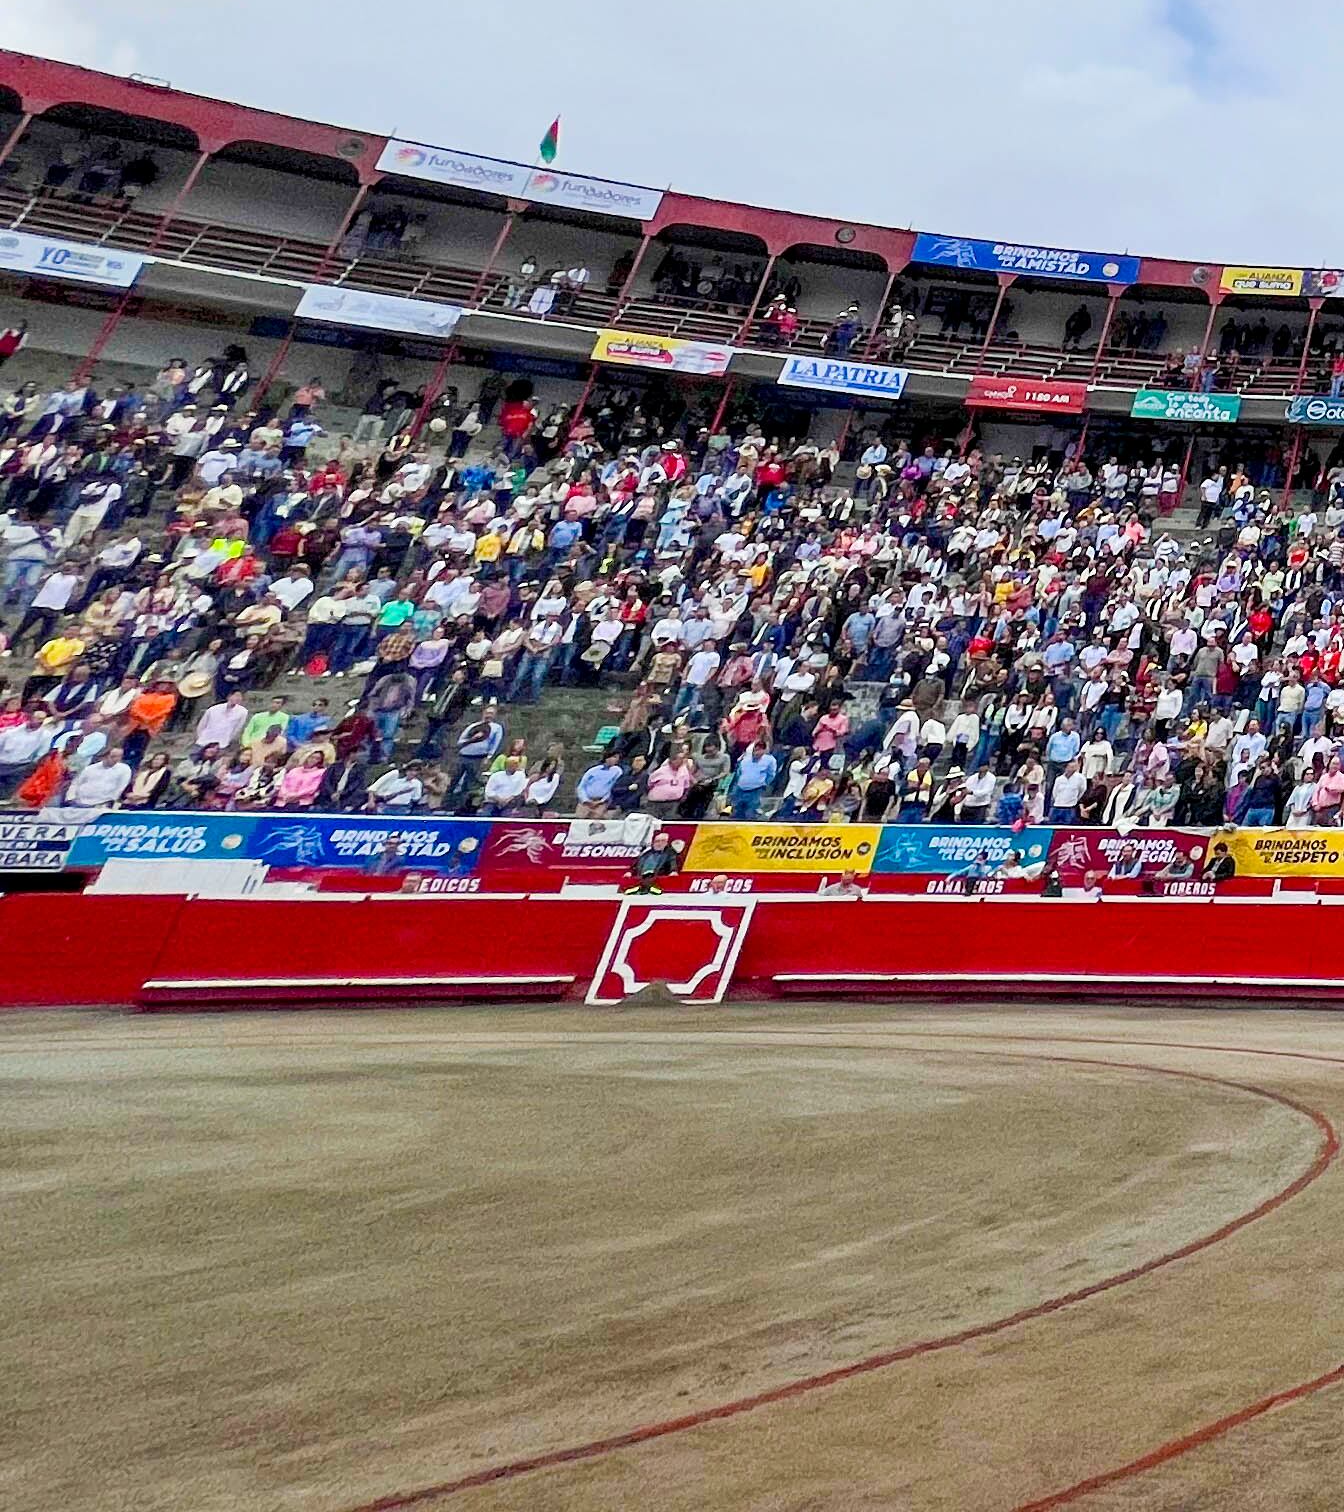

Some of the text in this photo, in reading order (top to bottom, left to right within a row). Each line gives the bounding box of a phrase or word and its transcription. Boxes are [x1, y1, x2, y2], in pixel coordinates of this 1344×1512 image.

[428, 154, 514, 182] fundadores
[992, 244, 1080, 263] BRINDAMOS
[1012, 259, 1091, 276] AMISTAD
[790, 359, 819, 377] LA
[822, 364, 901, 387] PATRIA
[1165, 407, 1231, 421] encanta
[76, 824, 208, 839] BRINDAMOS
[123, 838, 207, 853] SALUD
[751, 835, 842, 848] BRINDAMOS
[928, 836, 1013, 849] BRINDAMOS
[1254, 839, 1328, 851] BRINDAMOS
[353, 842, 451, 857] AMSTAD
[1273, 850, 1340, 864] RESPETO
[415, 877, 482, 893] EDICOS
[1163, 881, 1217, 896] TOREROS
